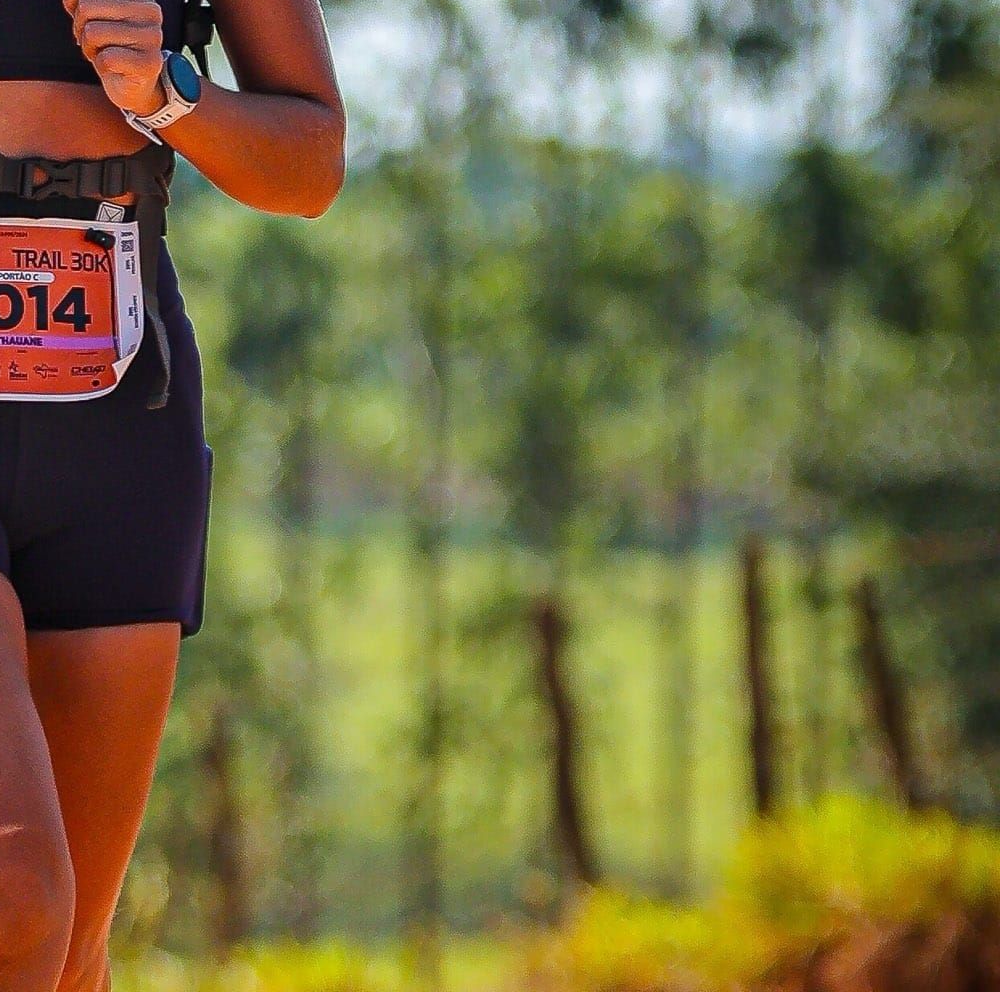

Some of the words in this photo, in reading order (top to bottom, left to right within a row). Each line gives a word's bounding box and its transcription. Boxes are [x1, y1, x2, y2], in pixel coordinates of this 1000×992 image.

[12, 249, 68, 270] TRAIL
[71, 252, 109, 273] 30K
[33, 273, 39, 281] C
